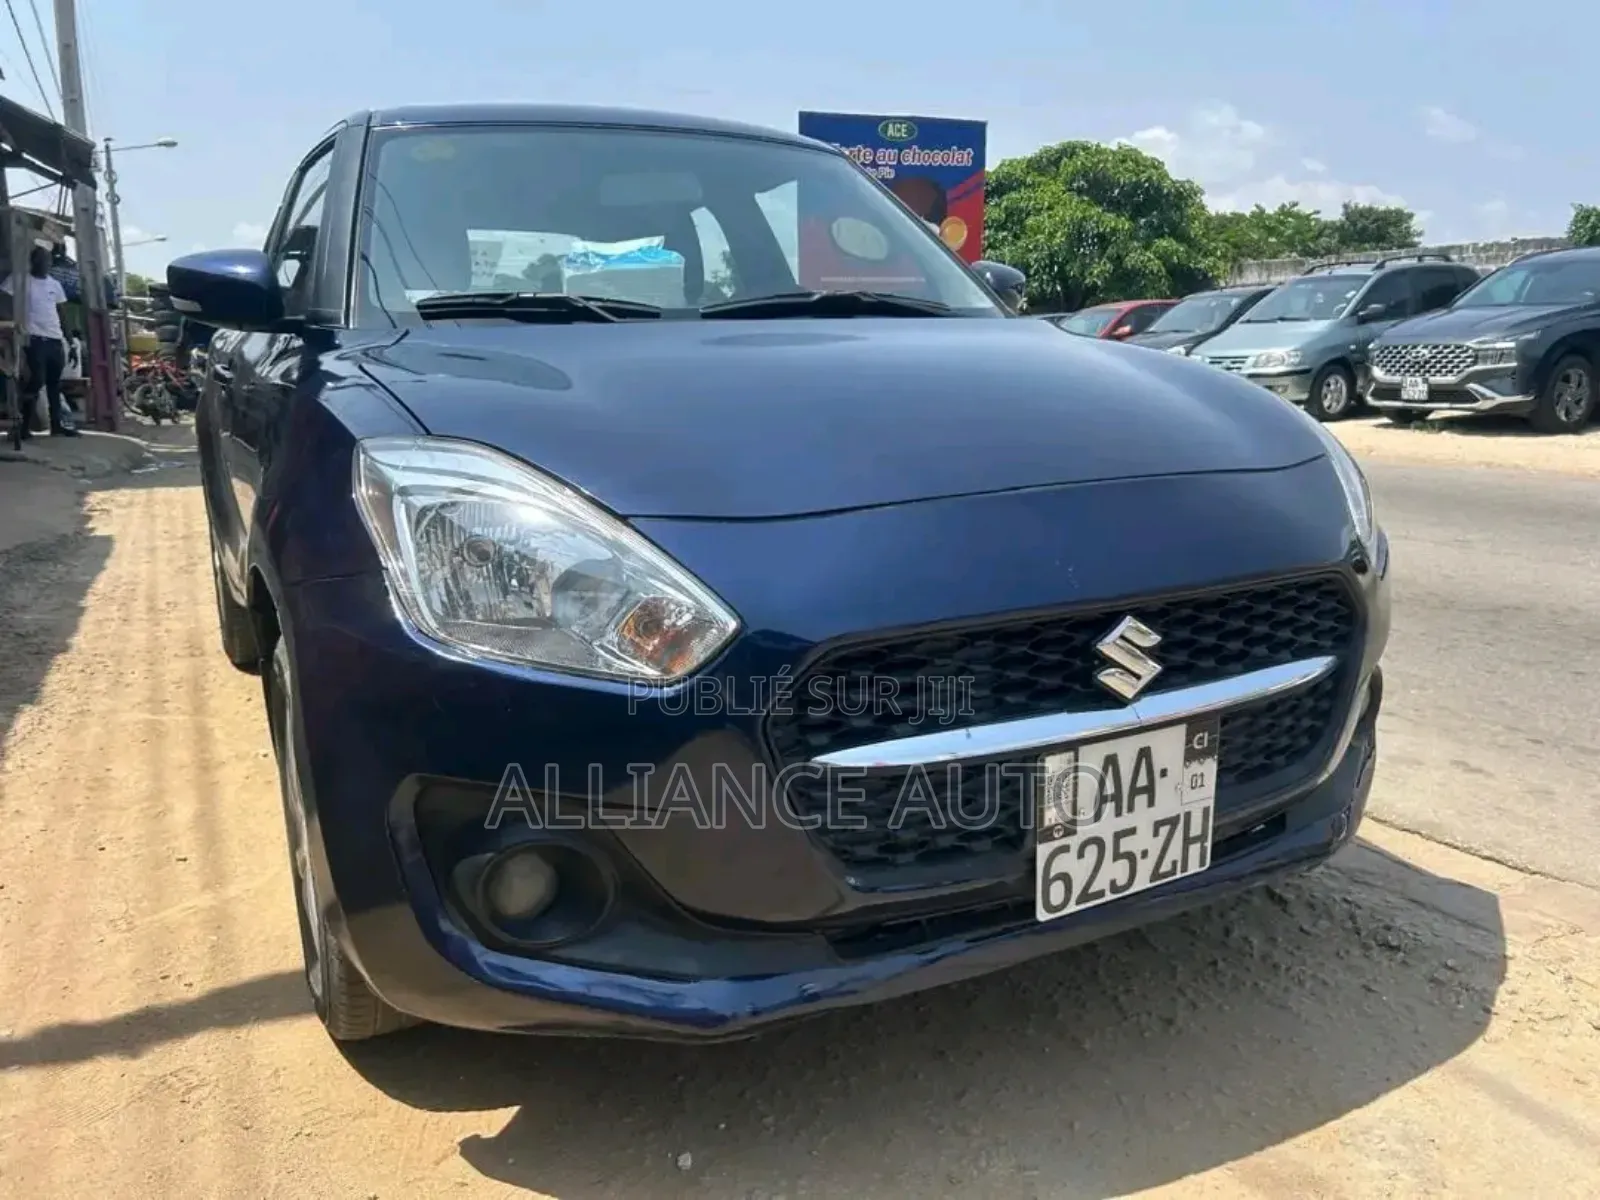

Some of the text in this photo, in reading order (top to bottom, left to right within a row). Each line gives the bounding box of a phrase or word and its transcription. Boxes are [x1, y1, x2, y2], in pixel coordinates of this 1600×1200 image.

[886, 123, 909, 138] ACE
[875, 147, 899, 165] au
[900, 144, 975, 167] chocolat
[1192, 730, 1209, 750] CI
[1190, 771, 1206, 791] 01
